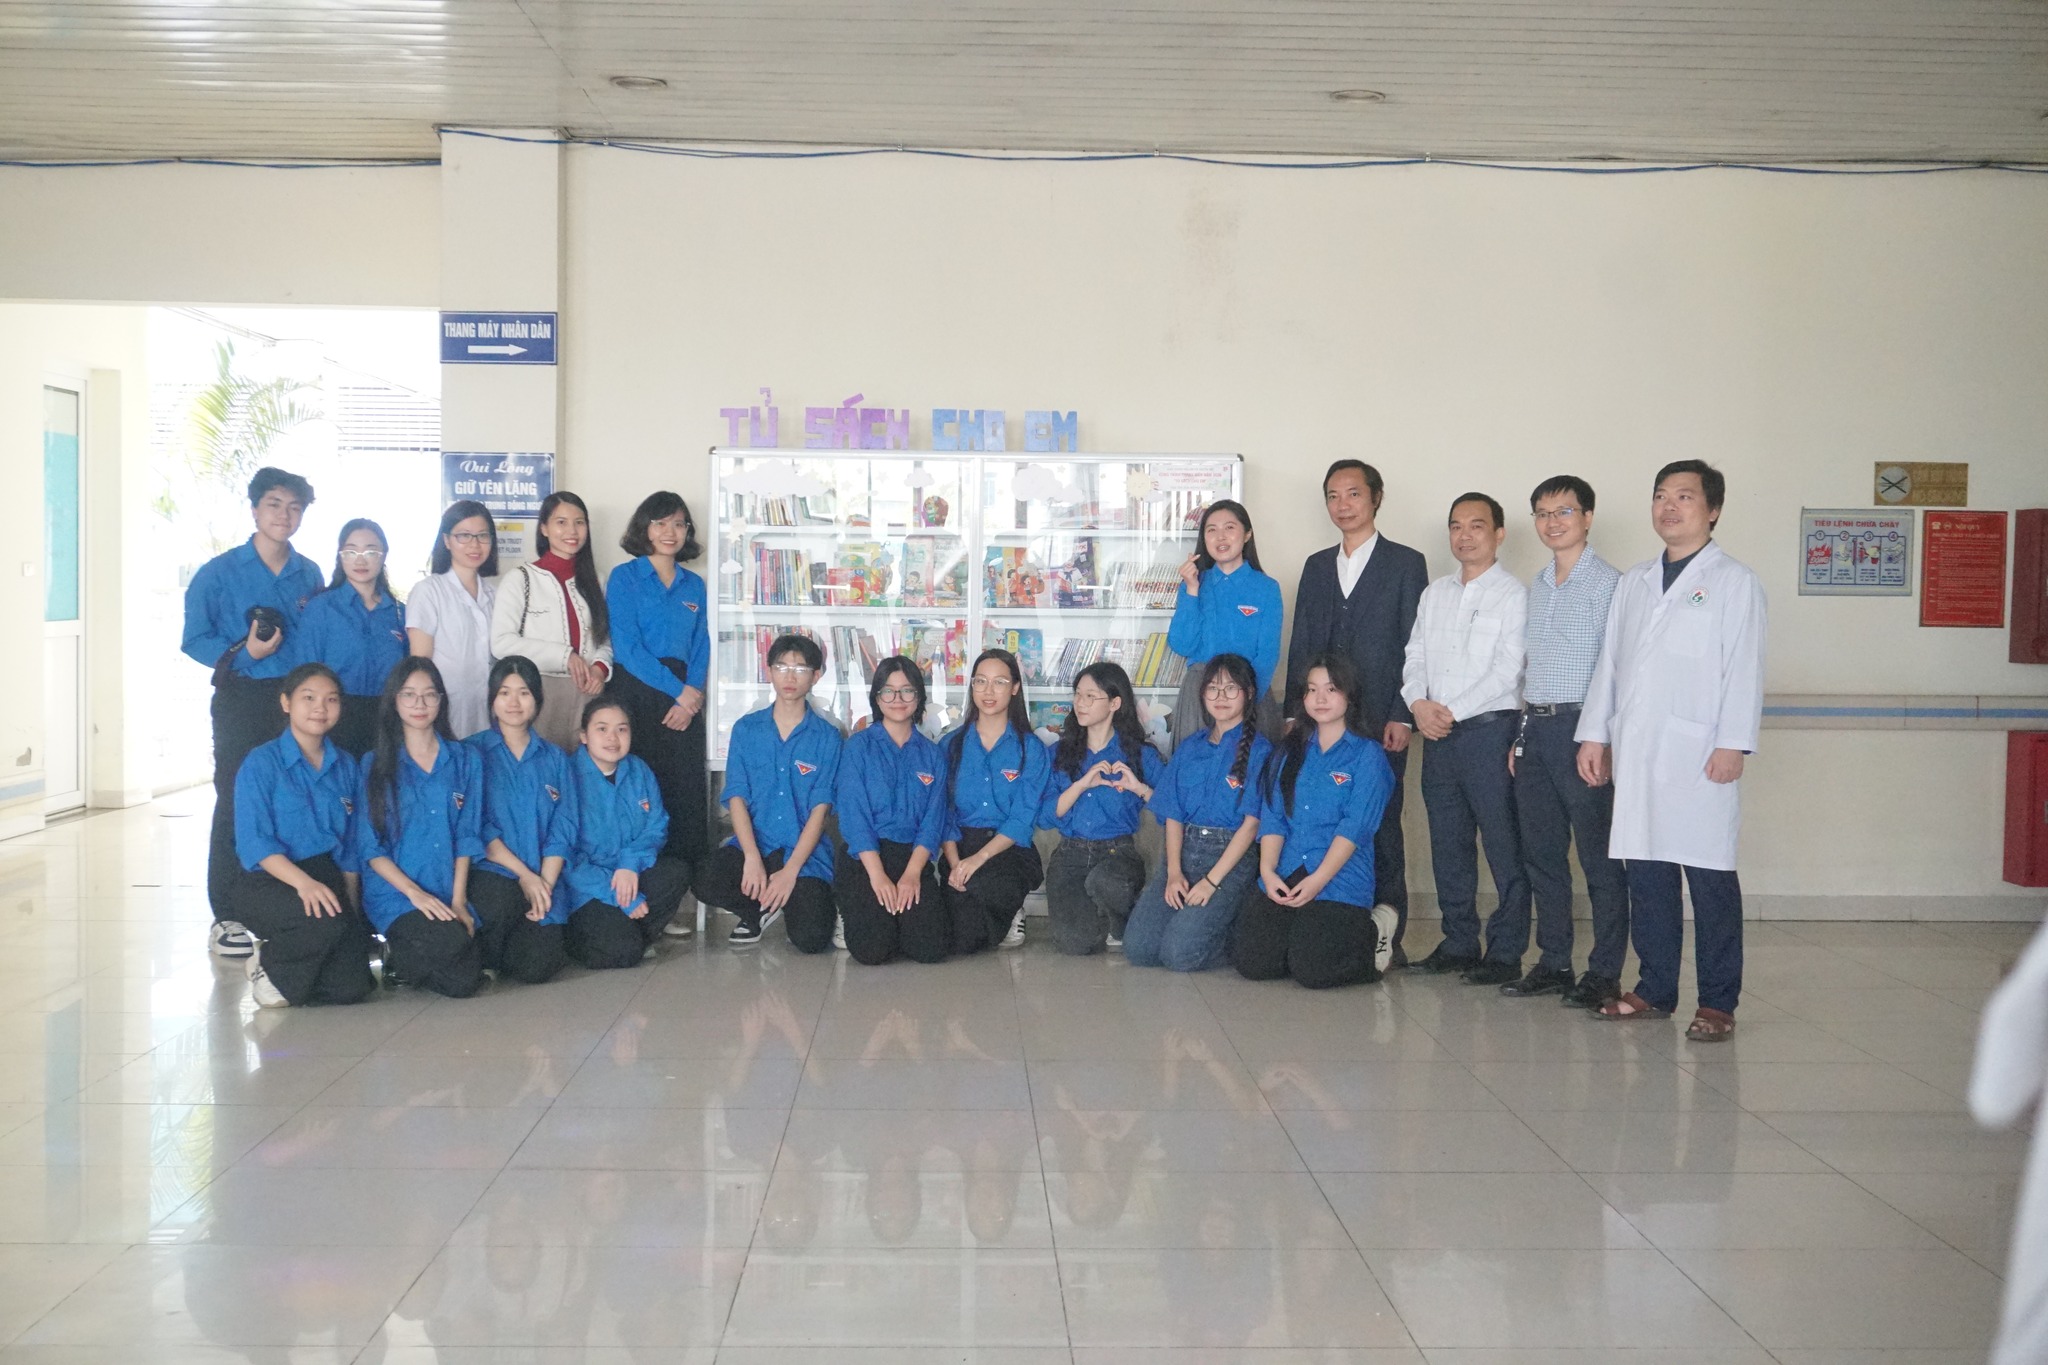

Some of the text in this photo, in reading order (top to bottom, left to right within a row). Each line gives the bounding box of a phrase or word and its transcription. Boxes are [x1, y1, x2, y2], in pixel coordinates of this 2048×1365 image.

[443, 319, 551, 339] THANG MÁY NHÂN DÂN
[719, 386, 779, 448] TỦ
[804, 393, 910, 450] SÁCH
[931, 408, 1006, 452] CHO
[459, 460, 491, 473] Vui
[454, 479, 538, 498] GIỮ YÊN LẶNG
